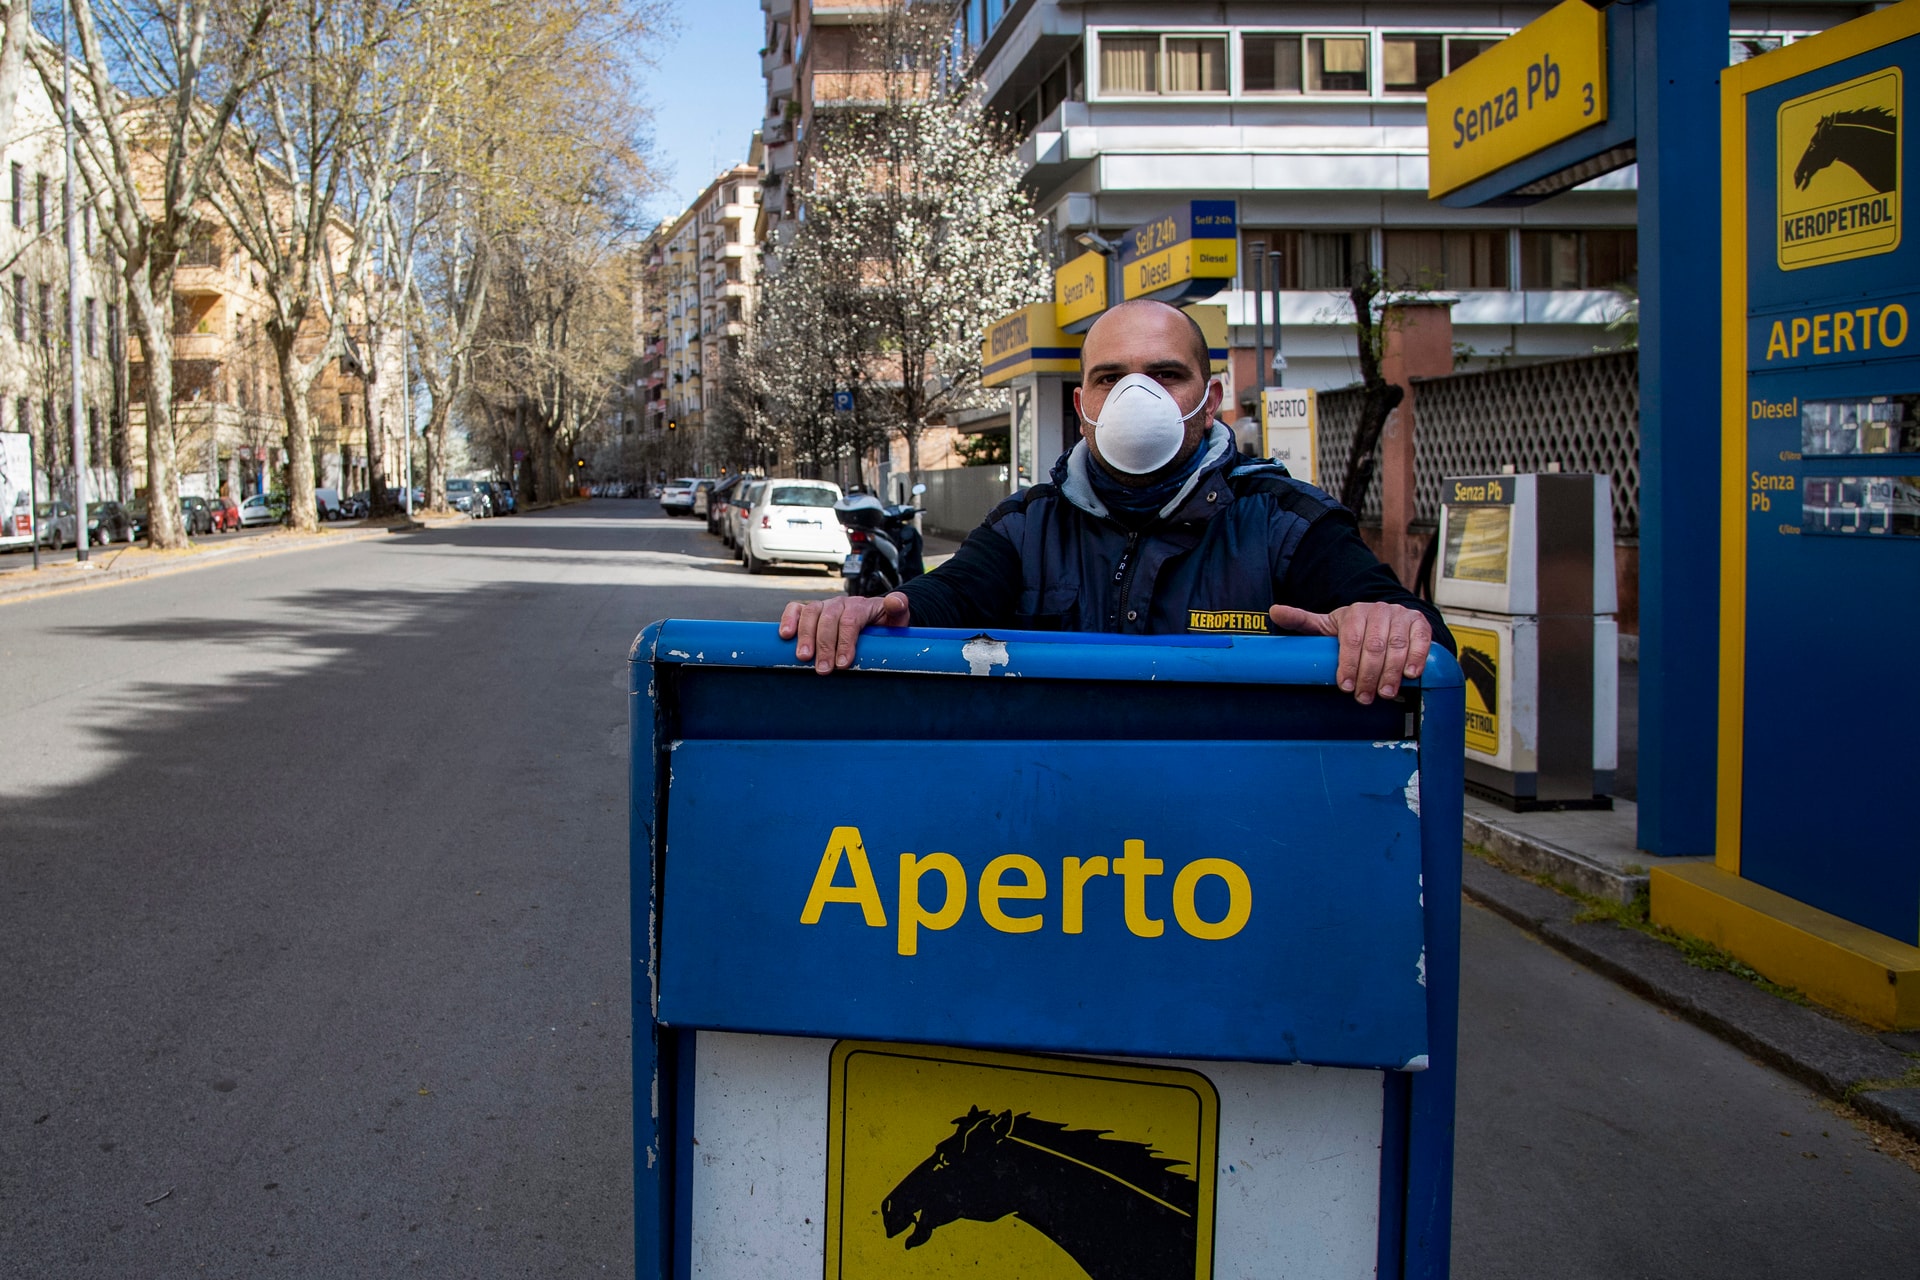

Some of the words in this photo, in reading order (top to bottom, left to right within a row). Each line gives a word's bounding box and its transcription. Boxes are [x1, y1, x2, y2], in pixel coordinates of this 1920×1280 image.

[1453, 86, 1518, 149] Senza
[1527, 53, 1560, 110] Pb
[1582, 82, 1595, 116] 3
[1195, 215, 1213, 225] Self
[1215, 215, 1232, 225] 24h
[1784, 198, 1892, 242] KEROPETROL
[1136, 223, 1155, 256] Self
[1156, 215, 1177, 248] 24h
[1185, 255, 1190, 274] 2
[1200, 254, 1228, 263] Diesel
[1140, 253, 1171, 288] Diesel
[1064, 282, 1083, 306] Senza
[1085, 271, 1094, 297] Pb
[1766, 303, 1909, 361] APERTO
[838, 395, 848, 410] P
[1267, 398, 1306, 418] APERTO
[1751, 397, 1797, 419] Diesel
[1454, 481, 1485, 501] Senza
[1488, 480, 1503, 501] Pb
[1751, 472, 1795, 490] Senza
[1752, 492, 1770, 511] Pb
[1190, 612, 1267, 630] KEROPETROL
[1465, 711, 1496, 734] PETROL
[800, 826, 1252, 956] Aperto
